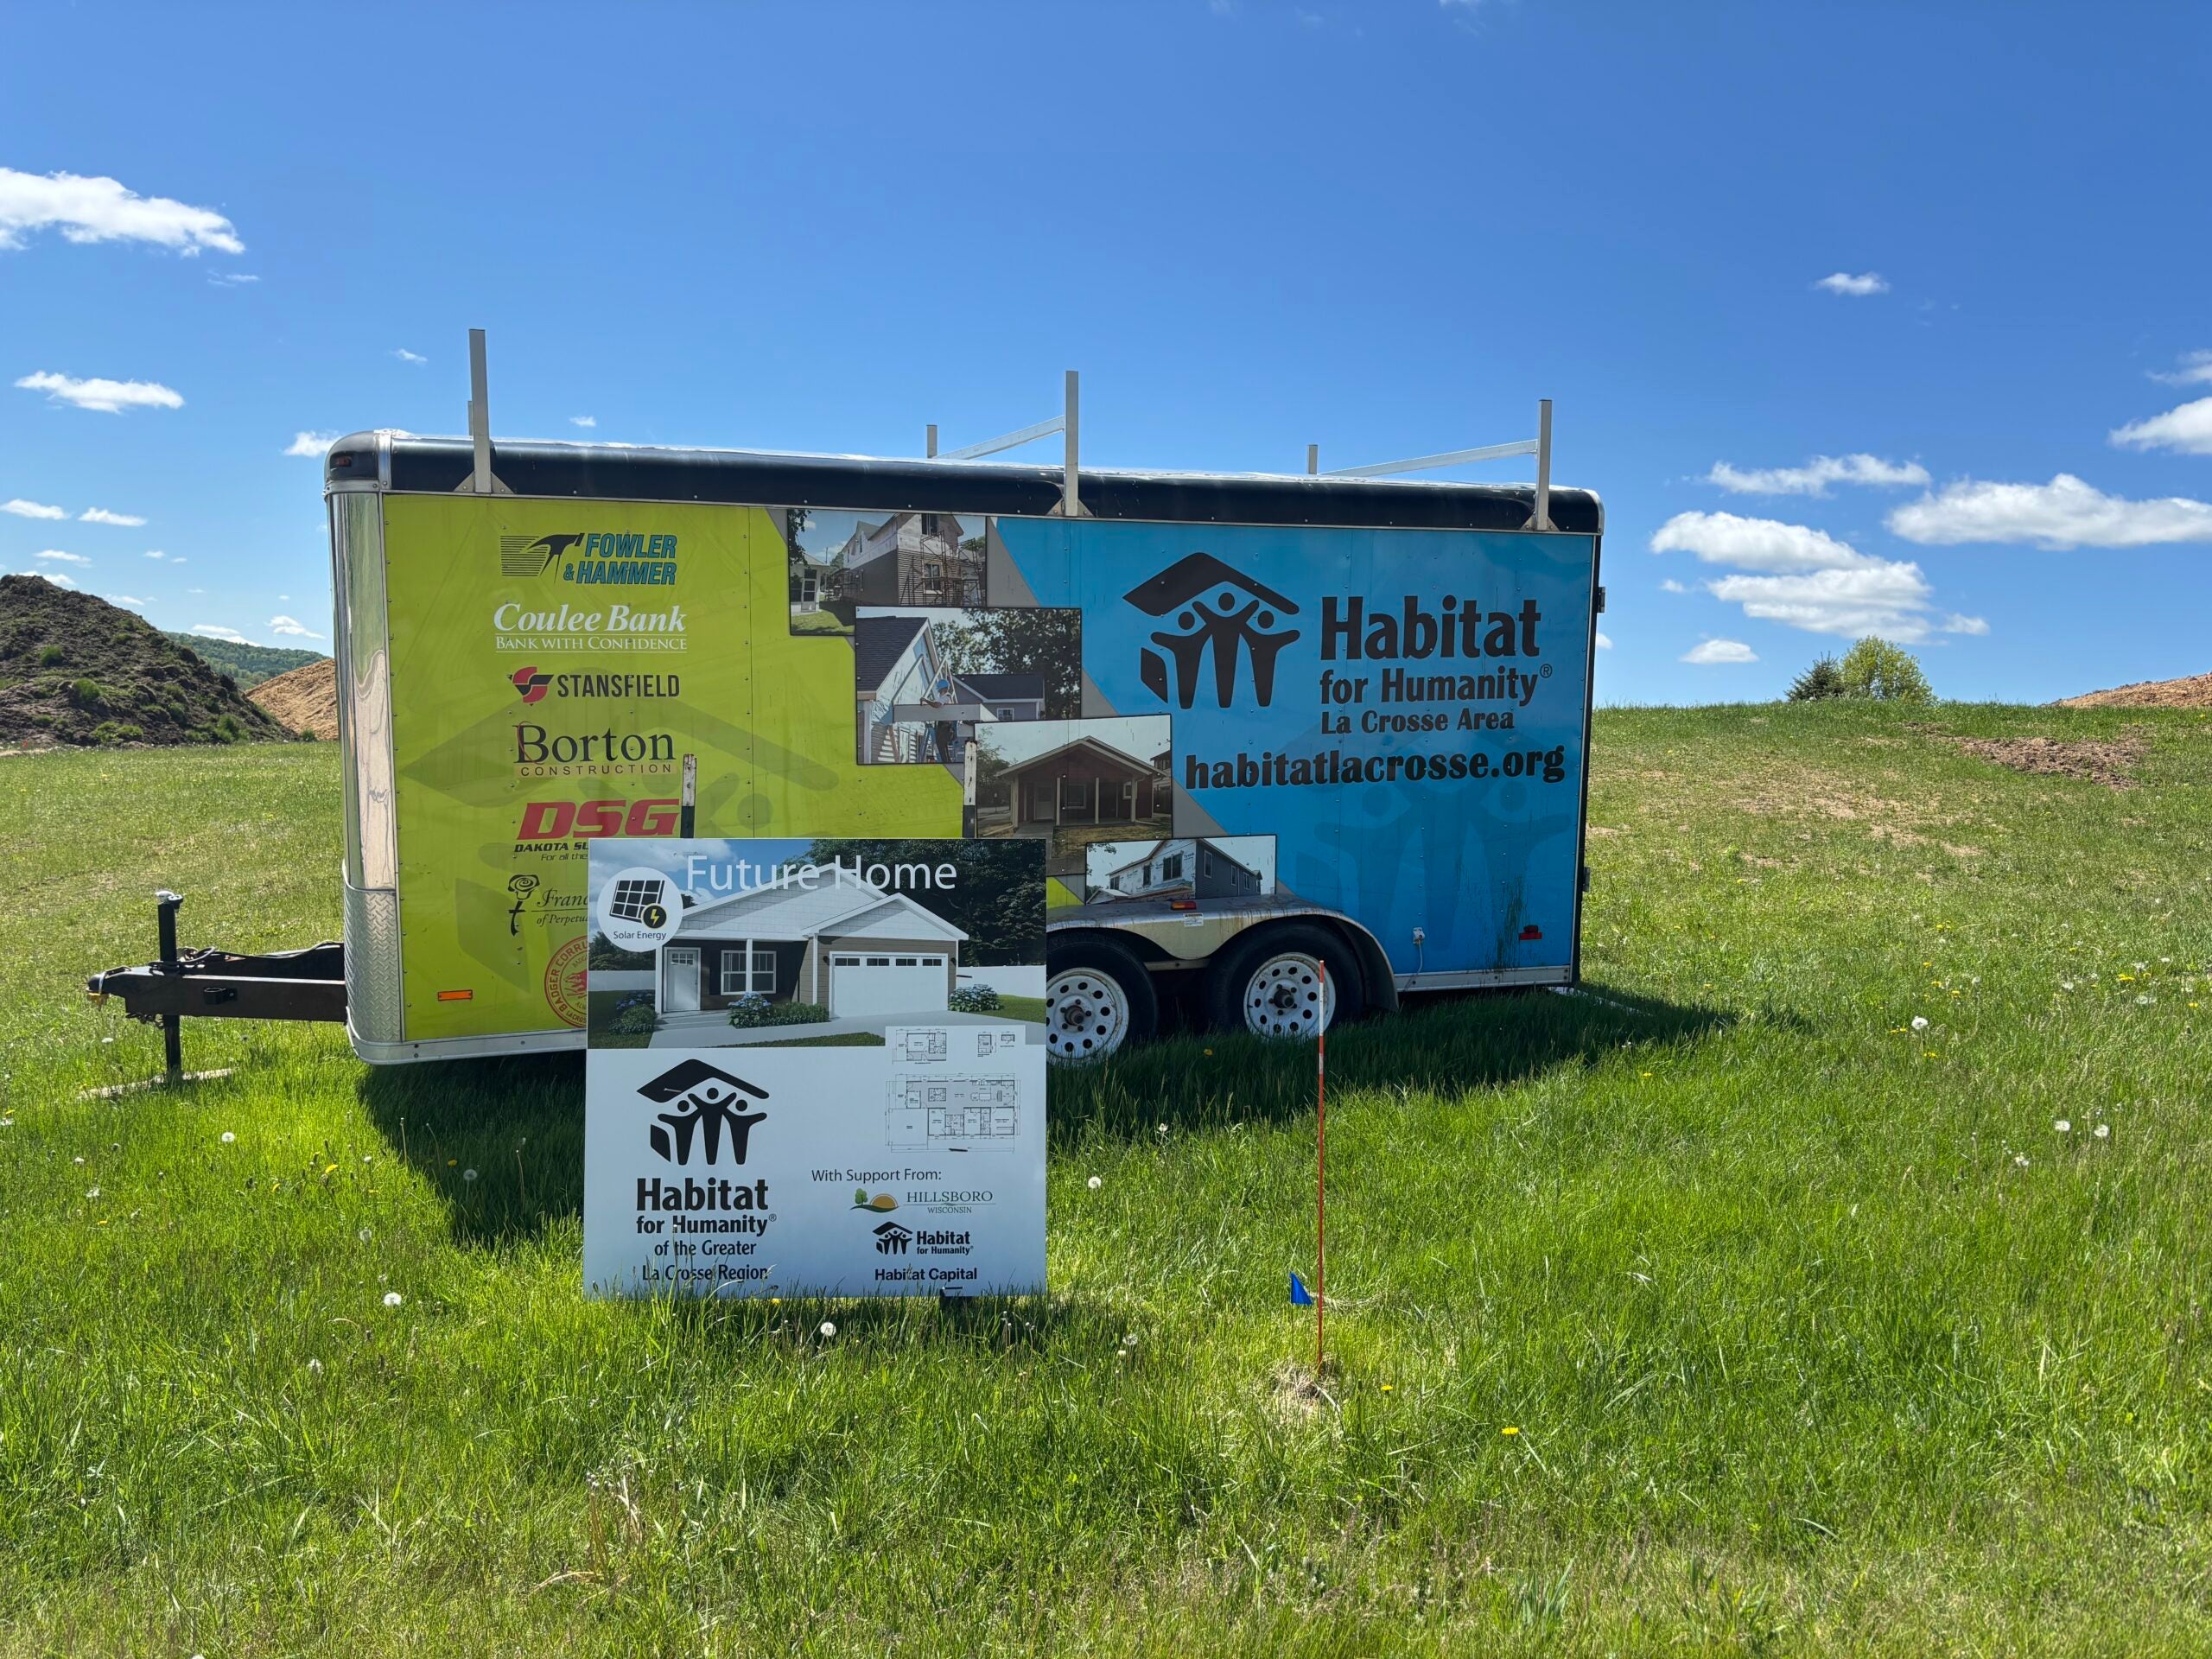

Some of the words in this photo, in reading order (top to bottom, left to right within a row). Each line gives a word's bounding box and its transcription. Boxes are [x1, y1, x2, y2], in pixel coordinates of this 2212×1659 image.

[585, 533, 677, 558] FOWLER
[563, 563, 575, 581] &
[576, 561, 677, 585] HAMMER
[493, 603, 601, 632] Coulee
[604, 605, 687, 632] Bank
[1320, 594, 1541, 660] Habitat
[496, 636, 538, 649] BANK
[542, 637, 583, 649] WITH
[588, 636, 687, 650] CONFIDENCE
[557, 674, 680, 697] STANSFIELD
[1319, 669, 1369, 705] for
[1321, 711, 1351, 734] La
[1361, 710, 1448, 733] Crosse
[1457, 708, 1515, 730] Area
[512, 722, 677, 764] Borton
[520, 764, 671, 776] CONSTRUCTION
[1185, 746, 1565, 790] habitatlacrosse.org
[517, 798, 680, 840] DSG
[514, 842, 569, 852] DAKOTA
[687, 855, 820, 891] Future
[836, 855, 957, 891] Home
[537, 913, 548, 927] of
[613, 931, 635, 939] Solar
[637, 931, 667, 941] Energy
[549, 969, 568, 1012] BADGER
[811, 1169, 842, 1182] With
[847, 1169, 900, 1184] Support
[904, 1168, 942, 1180] From:
[637, 1177, 768, 1211] Habitat
[906, 1191, 993, 1203] HILLSBORO
[636, 1215, 664, 1234] for
[654, 1240, 669, 1255] of
[674, 1240, 696, 1255] the
[702, 1239, 757, 1255] Greater
[917, 1230, 970, 1245] Habitat
[917, 1246, 929, 1255] for
[642, 1265, 659, 1281] La
[664, 1264, 713, 1281] Crosse
[718, 1264, 768, 1281] Region
[874, 1268, 925, 1281] Habitat
[928, 1268, 977, 1282] Capital
